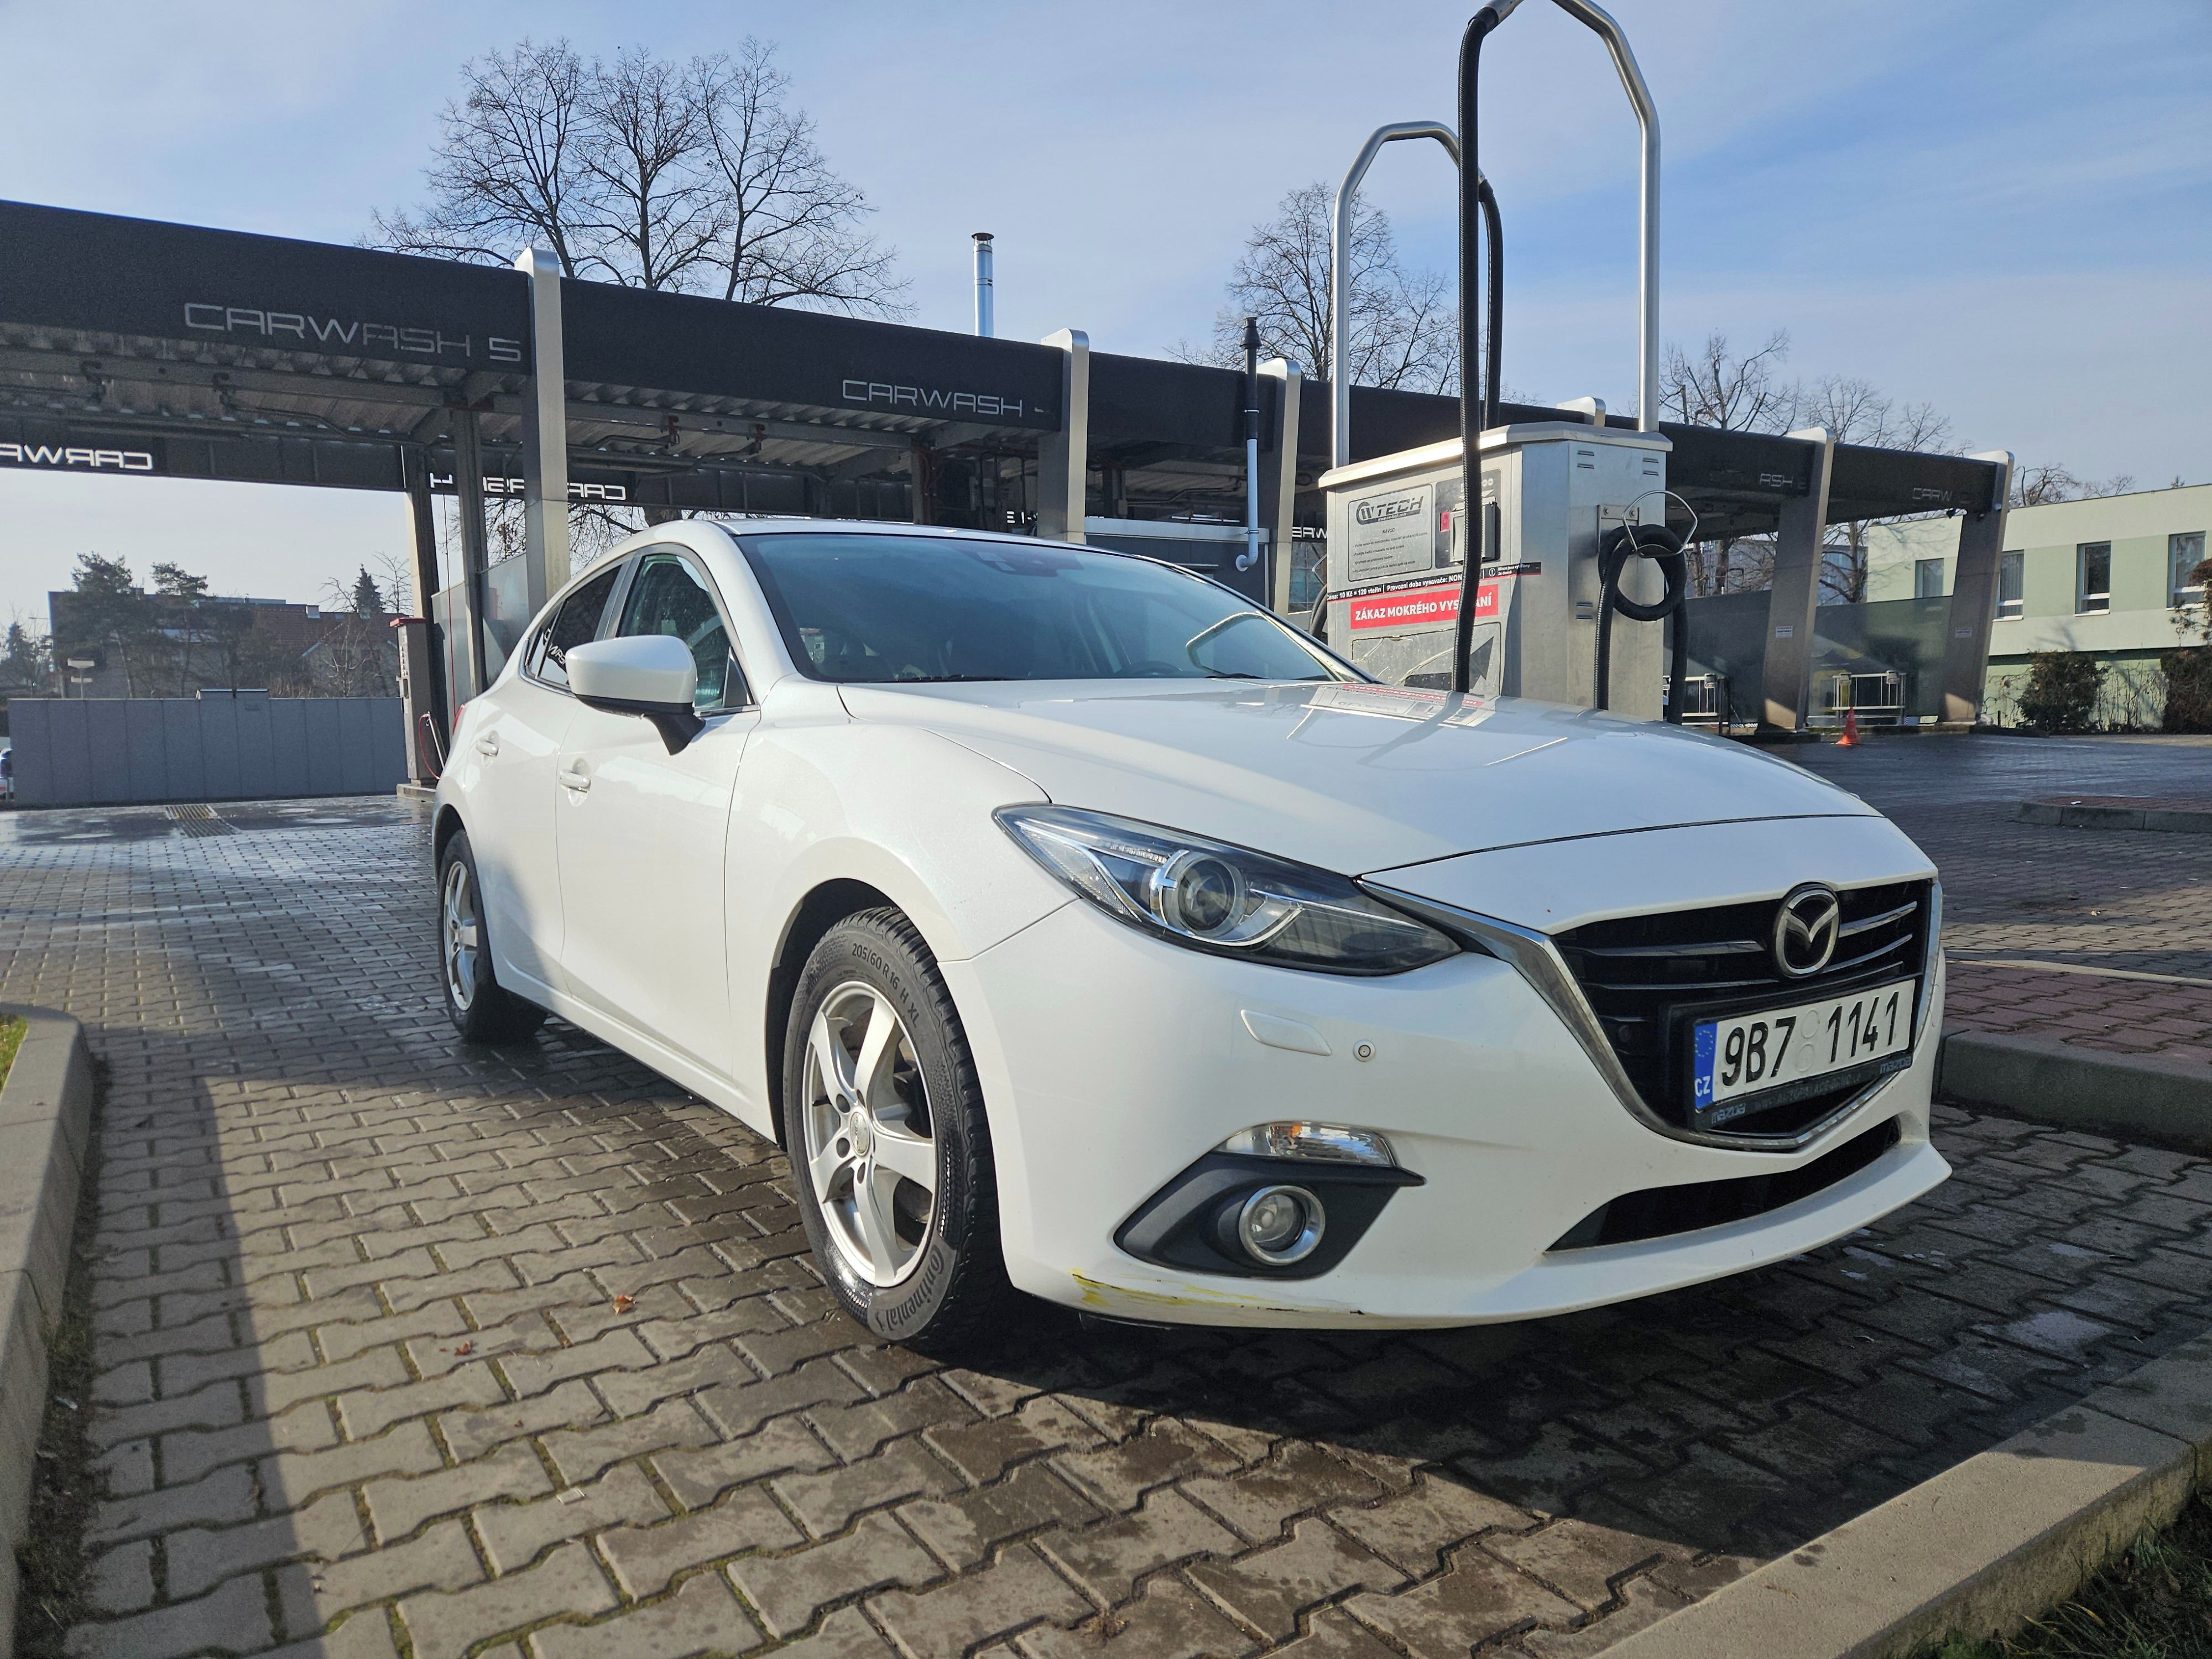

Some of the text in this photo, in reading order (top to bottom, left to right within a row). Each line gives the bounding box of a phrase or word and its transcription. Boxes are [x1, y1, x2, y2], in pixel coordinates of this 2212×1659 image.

[184, 302, 471, 357] CARWASH
[842, 379, 1022, 417] CARWASH
[1387, 582, 1408, 591] Provozní
[1422, 577, 1448, 587] vysavače:
[1355, 607, 1386, 620] ZÁKAZ
[1387, 601, 1437, 618] MOKRÉHO
[852, 942, 920, 1029] 205/60 R 16 H XL
[1721, 991, 1900, 1087] 9B7 1141
[1694, 1075, 1711, 1098] CZ
[886, 1244, 945, 1332] Continental
